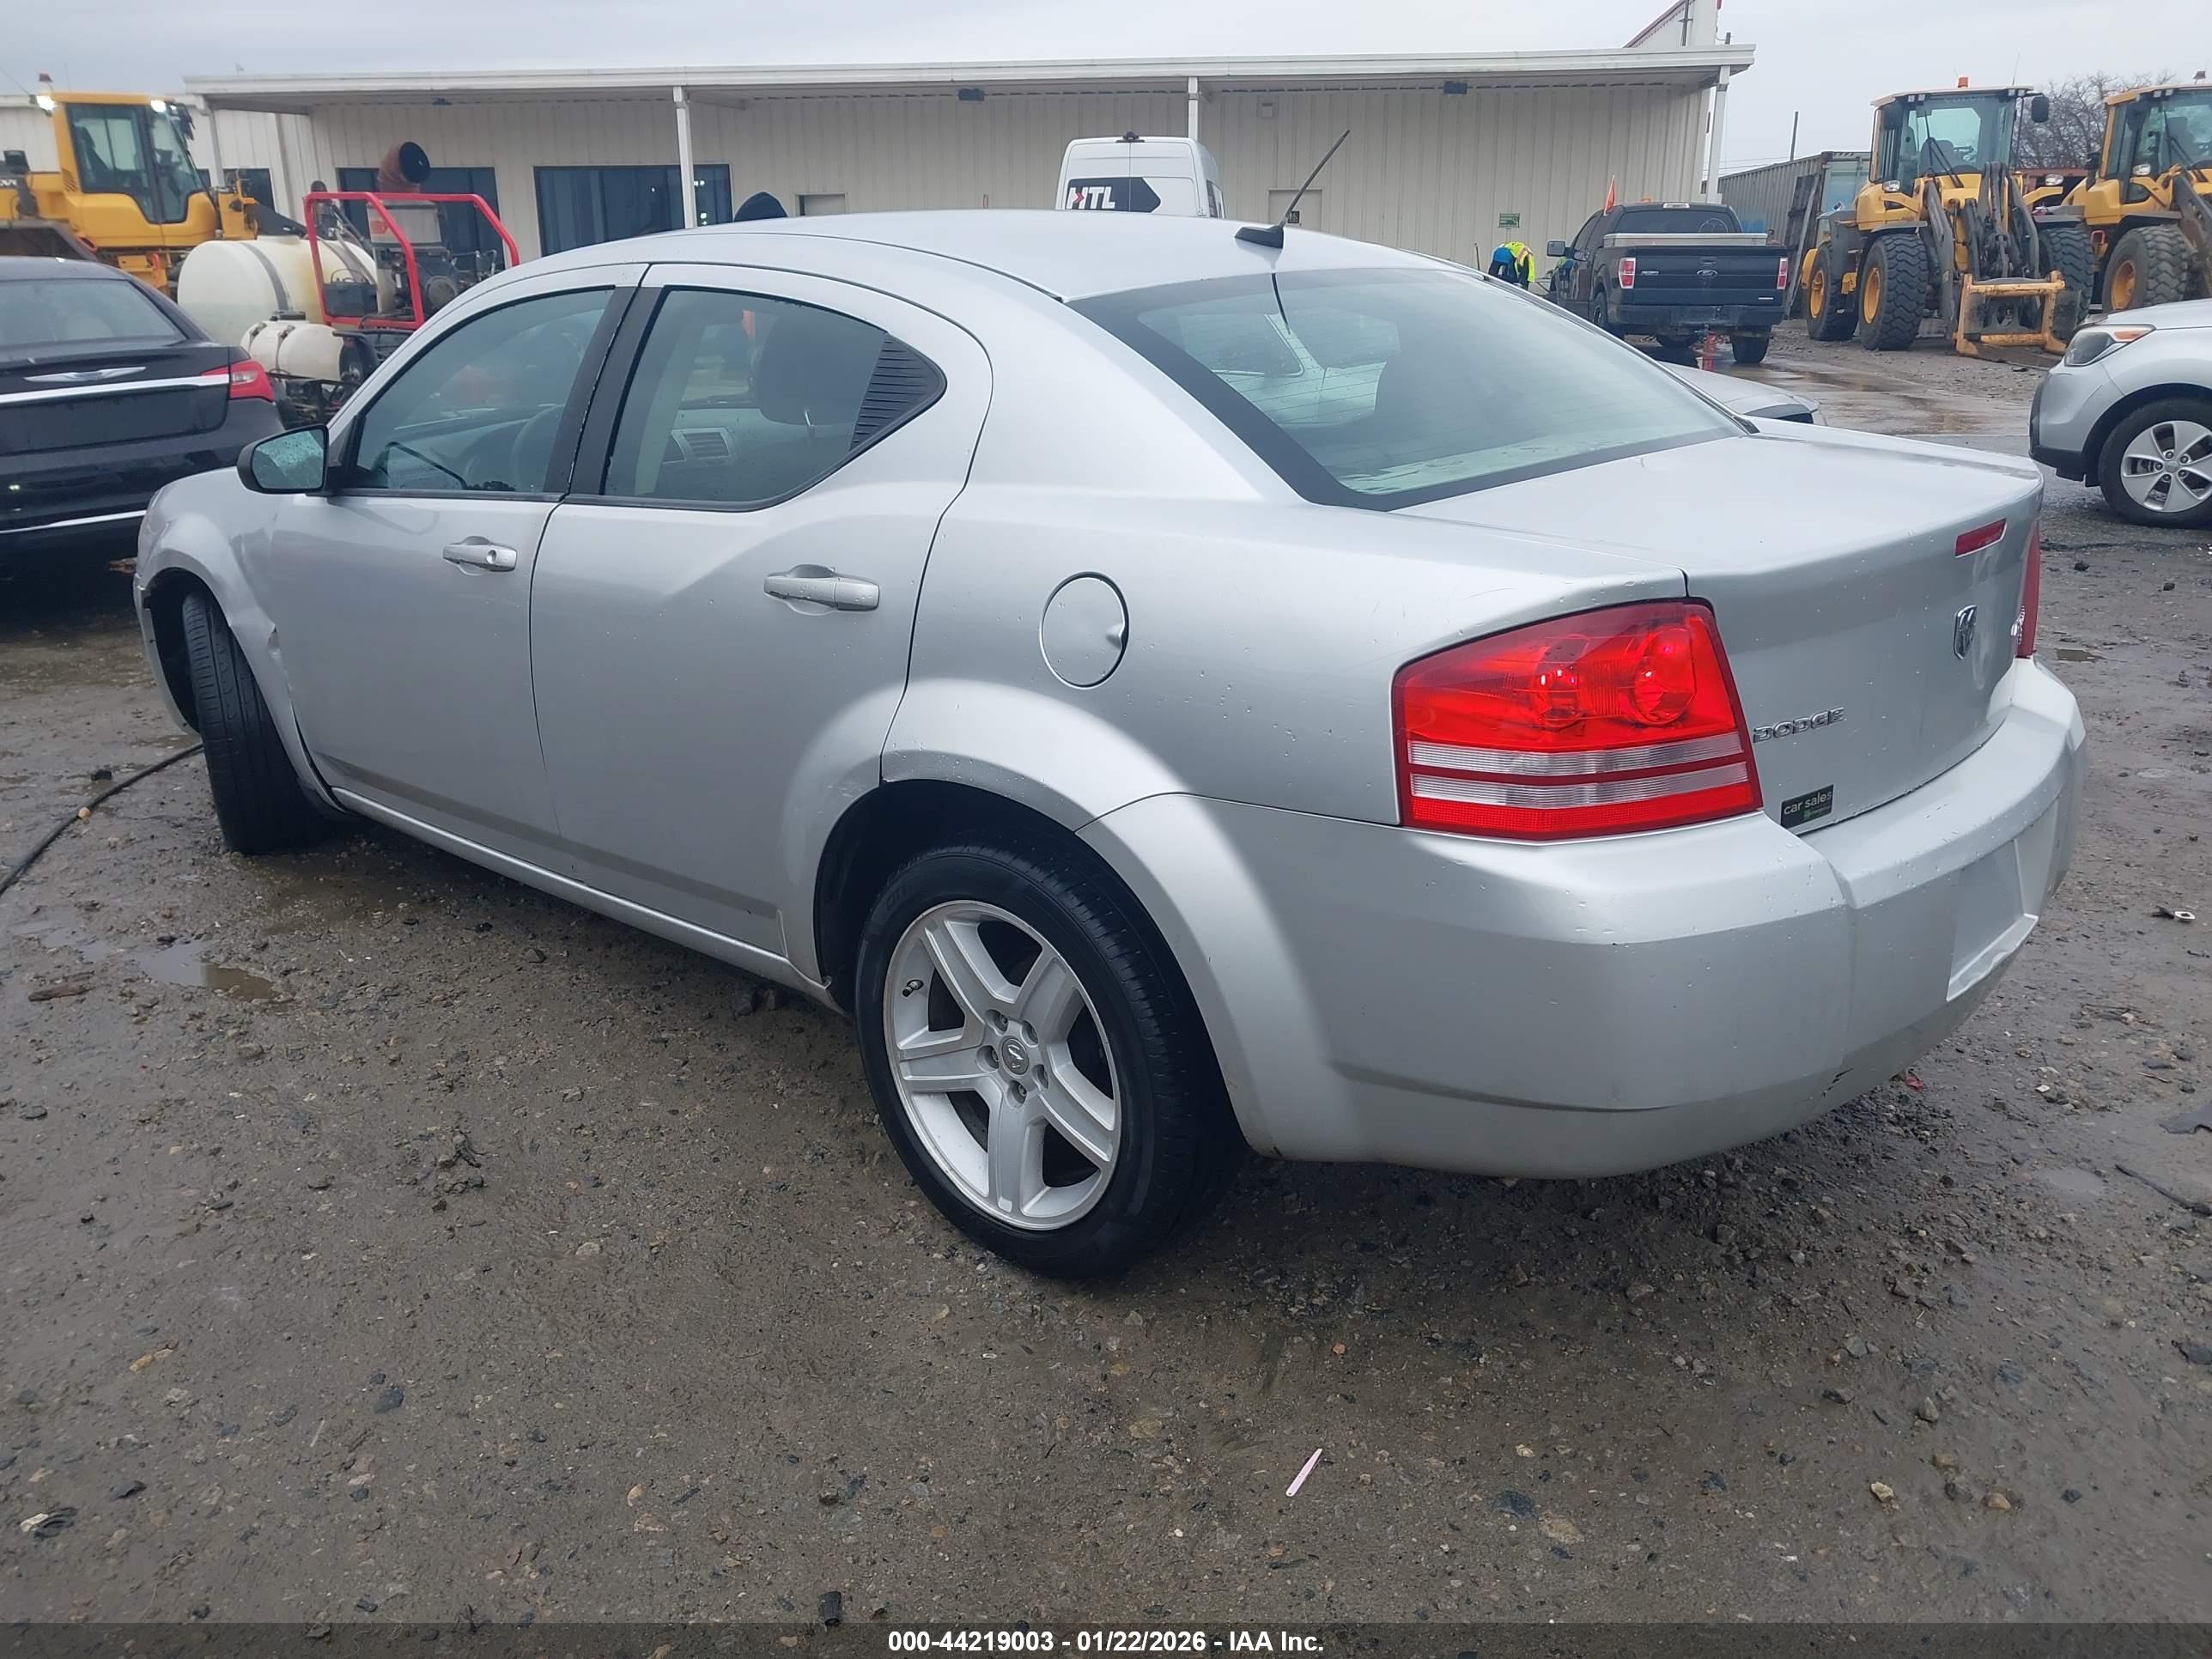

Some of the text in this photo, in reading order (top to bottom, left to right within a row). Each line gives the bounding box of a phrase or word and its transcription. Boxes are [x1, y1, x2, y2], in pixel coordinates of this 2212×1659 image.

[1066, 186, 1116, 210] HTL
[1753, 707, 1845, 744] DODGE
[1784, 802, 1803, 815] car
[1804, 792, 1832, 808] sales
